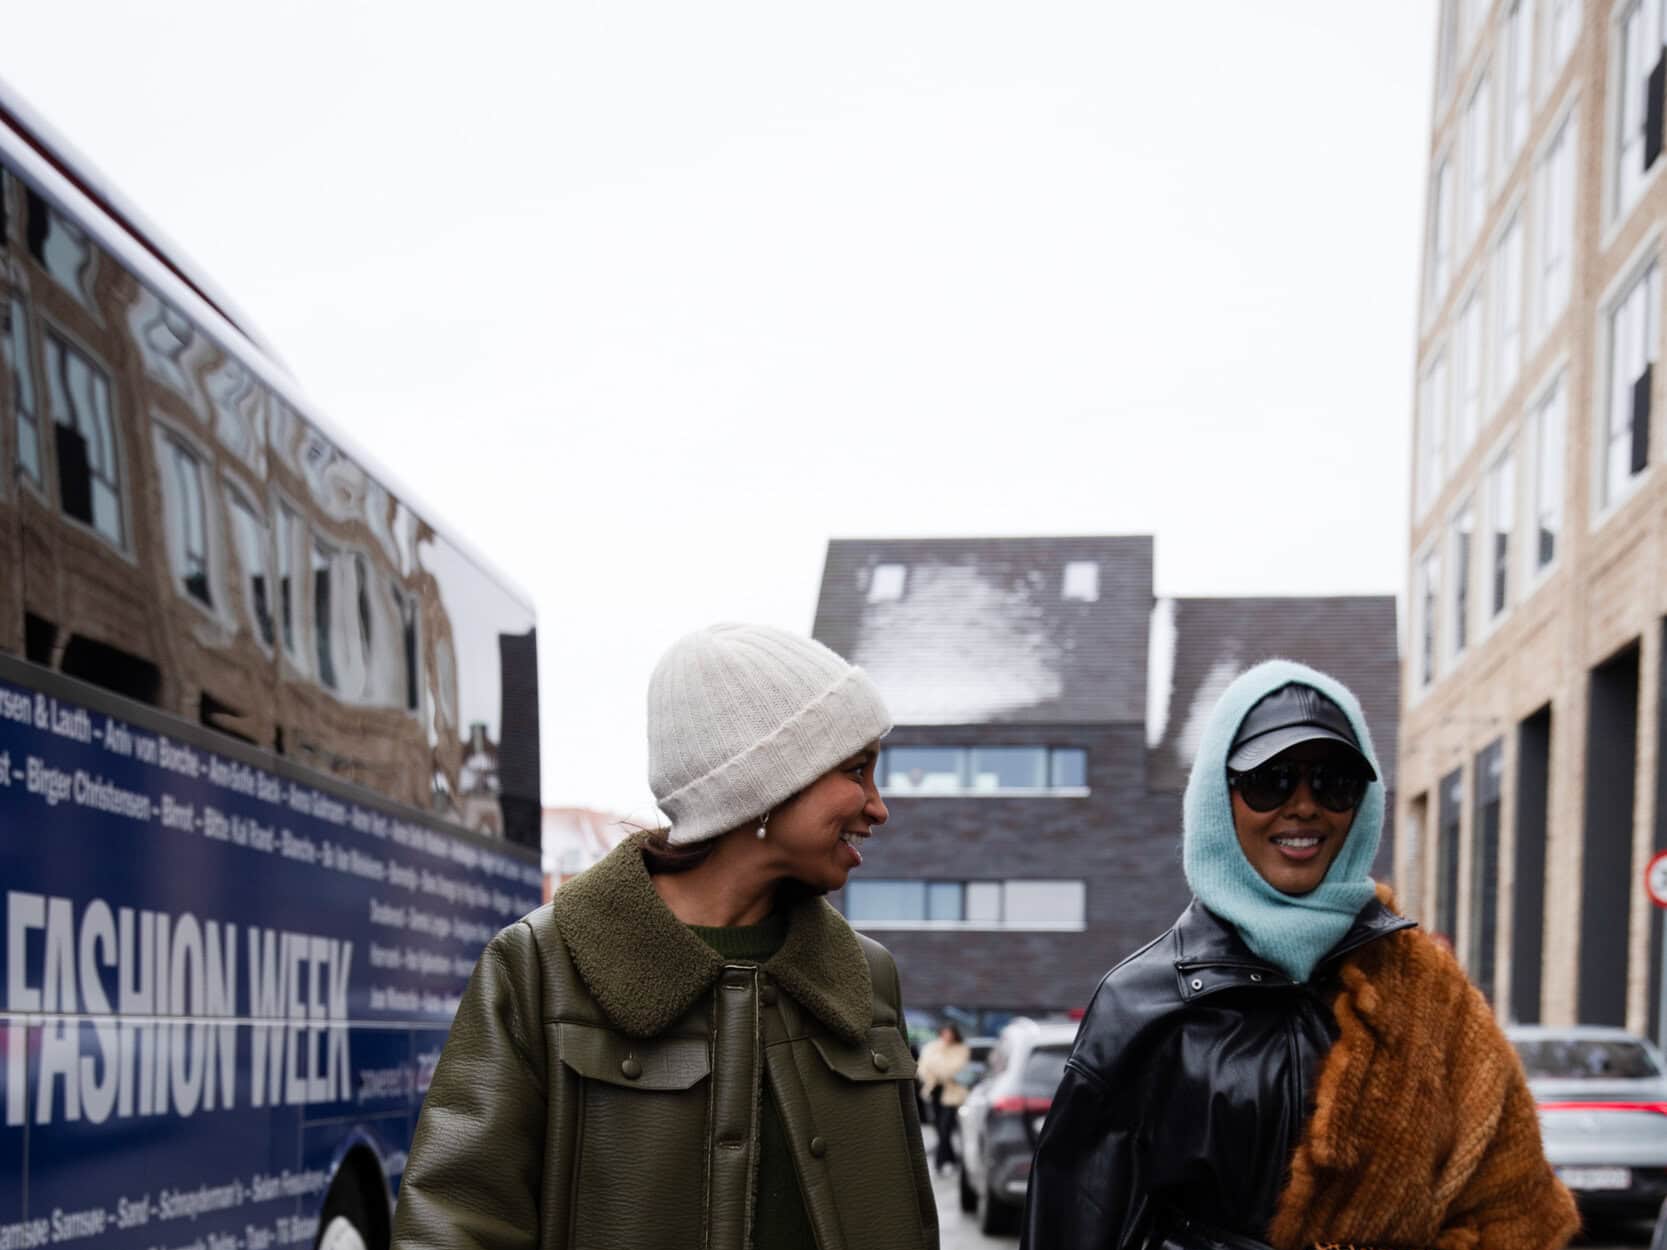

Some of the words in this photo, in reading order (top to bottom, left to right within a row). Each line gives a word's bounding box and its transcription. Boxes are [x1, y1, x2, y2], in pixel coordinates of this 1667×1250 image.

[33, 695, 48, 731] &
[26, 758, 73, 806] Birger
[73, 771, 151, 821] Christensen
[7, 890, 237, 1127] FASHION
[248, 926, 353, 1108] WEEK
